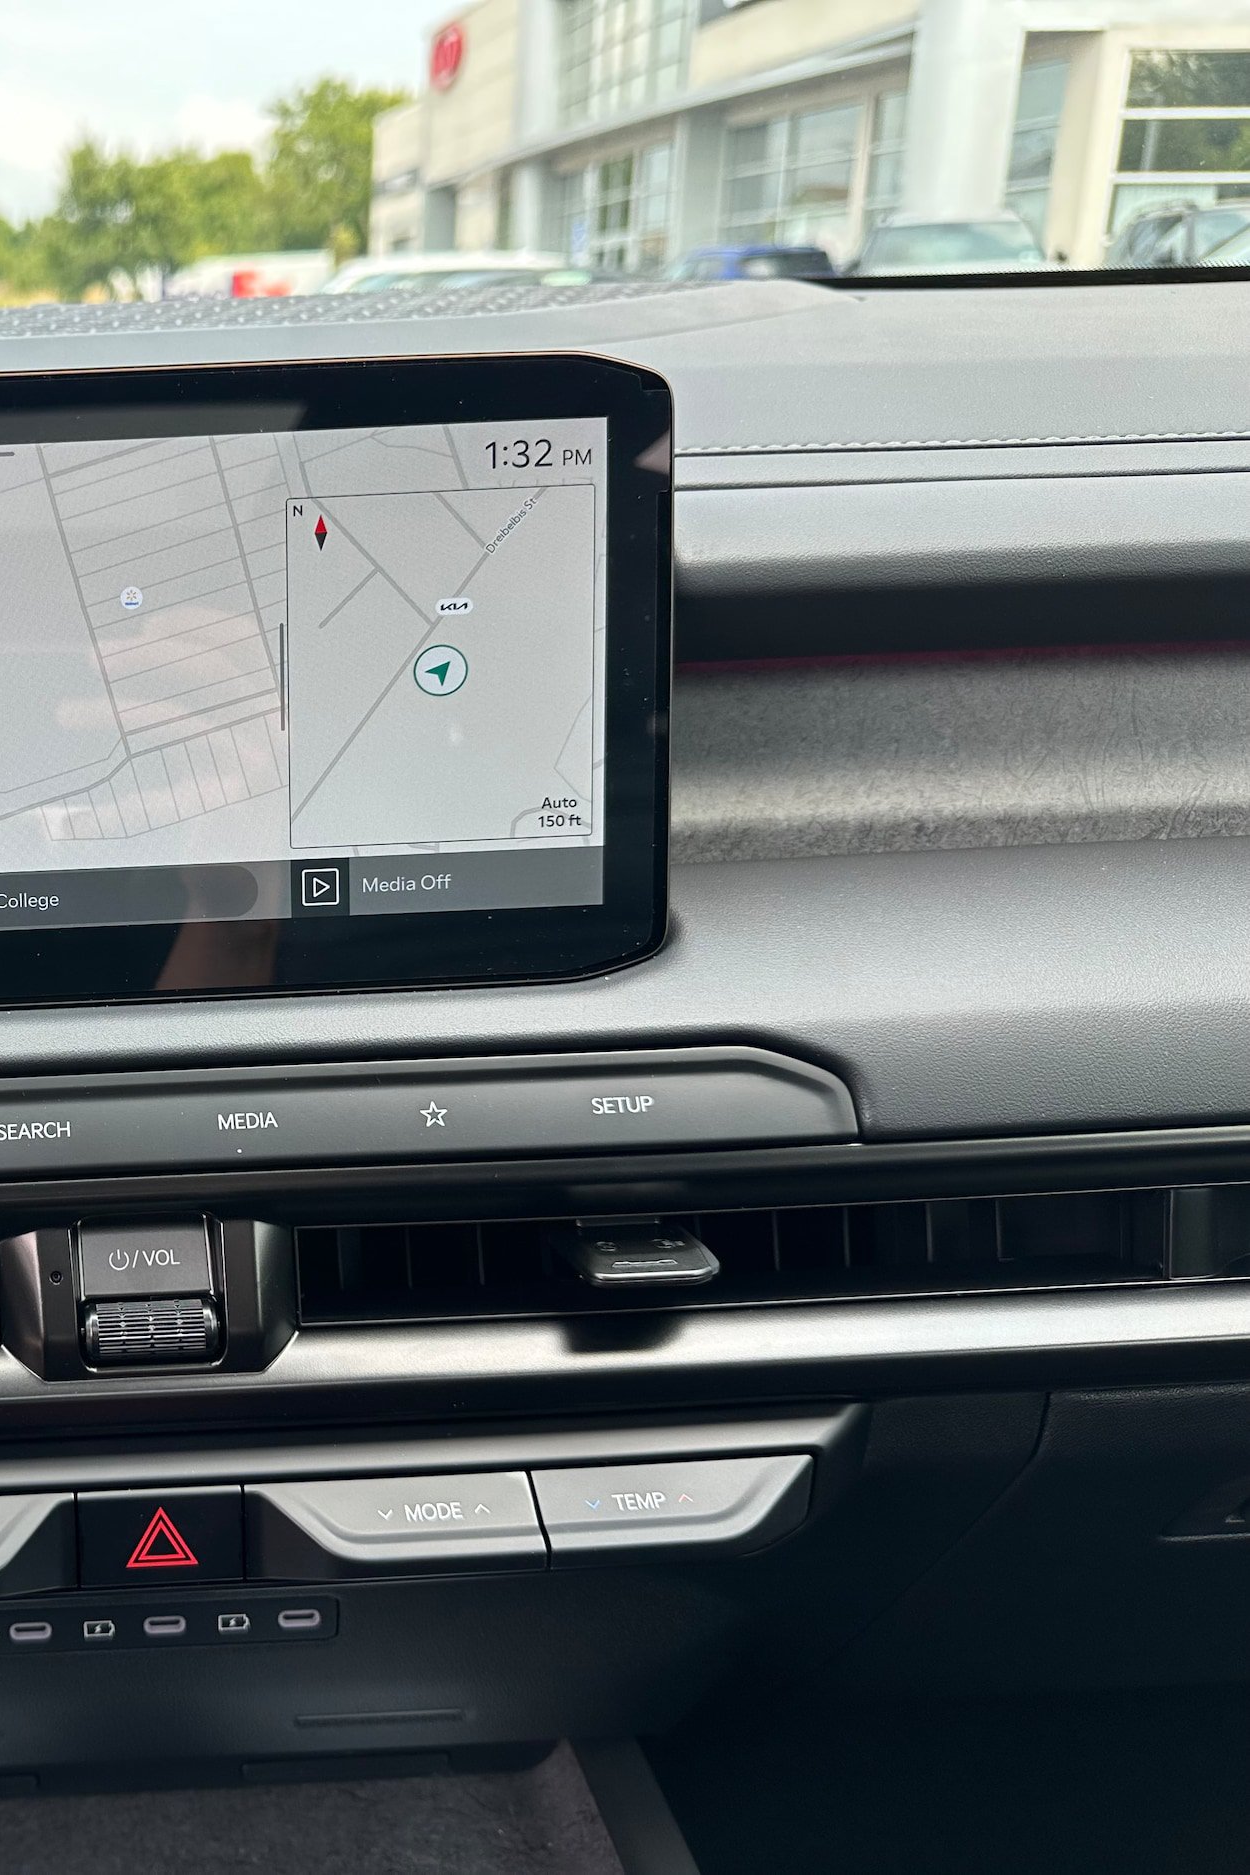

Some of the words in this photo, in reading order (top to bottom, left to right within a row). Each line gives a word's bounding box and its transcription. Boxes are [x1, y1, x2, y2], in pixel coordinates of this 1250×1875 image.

[485, 439, 553, 469] 1:32
[562, 448, 592, 466] PM
[293, 505, 303, 517] N
[485, 509, 527, 554] Dreibelbis
[523, 498, 537, 511] St
[541, 797, 577, 809] Auto
[538, 815, 565, 828] 150
[568, 814, 582, 827] ft
[362, 876, 416, 893] Media
[420, 874, 452, 890] Off
[591, 1095, 654, 1115] SETUP
[217, 1112, 279, 1130] MEDIA
[611, 1492, 666, 1511] TEMP
[404, 1502, 463, 1522] MODE
